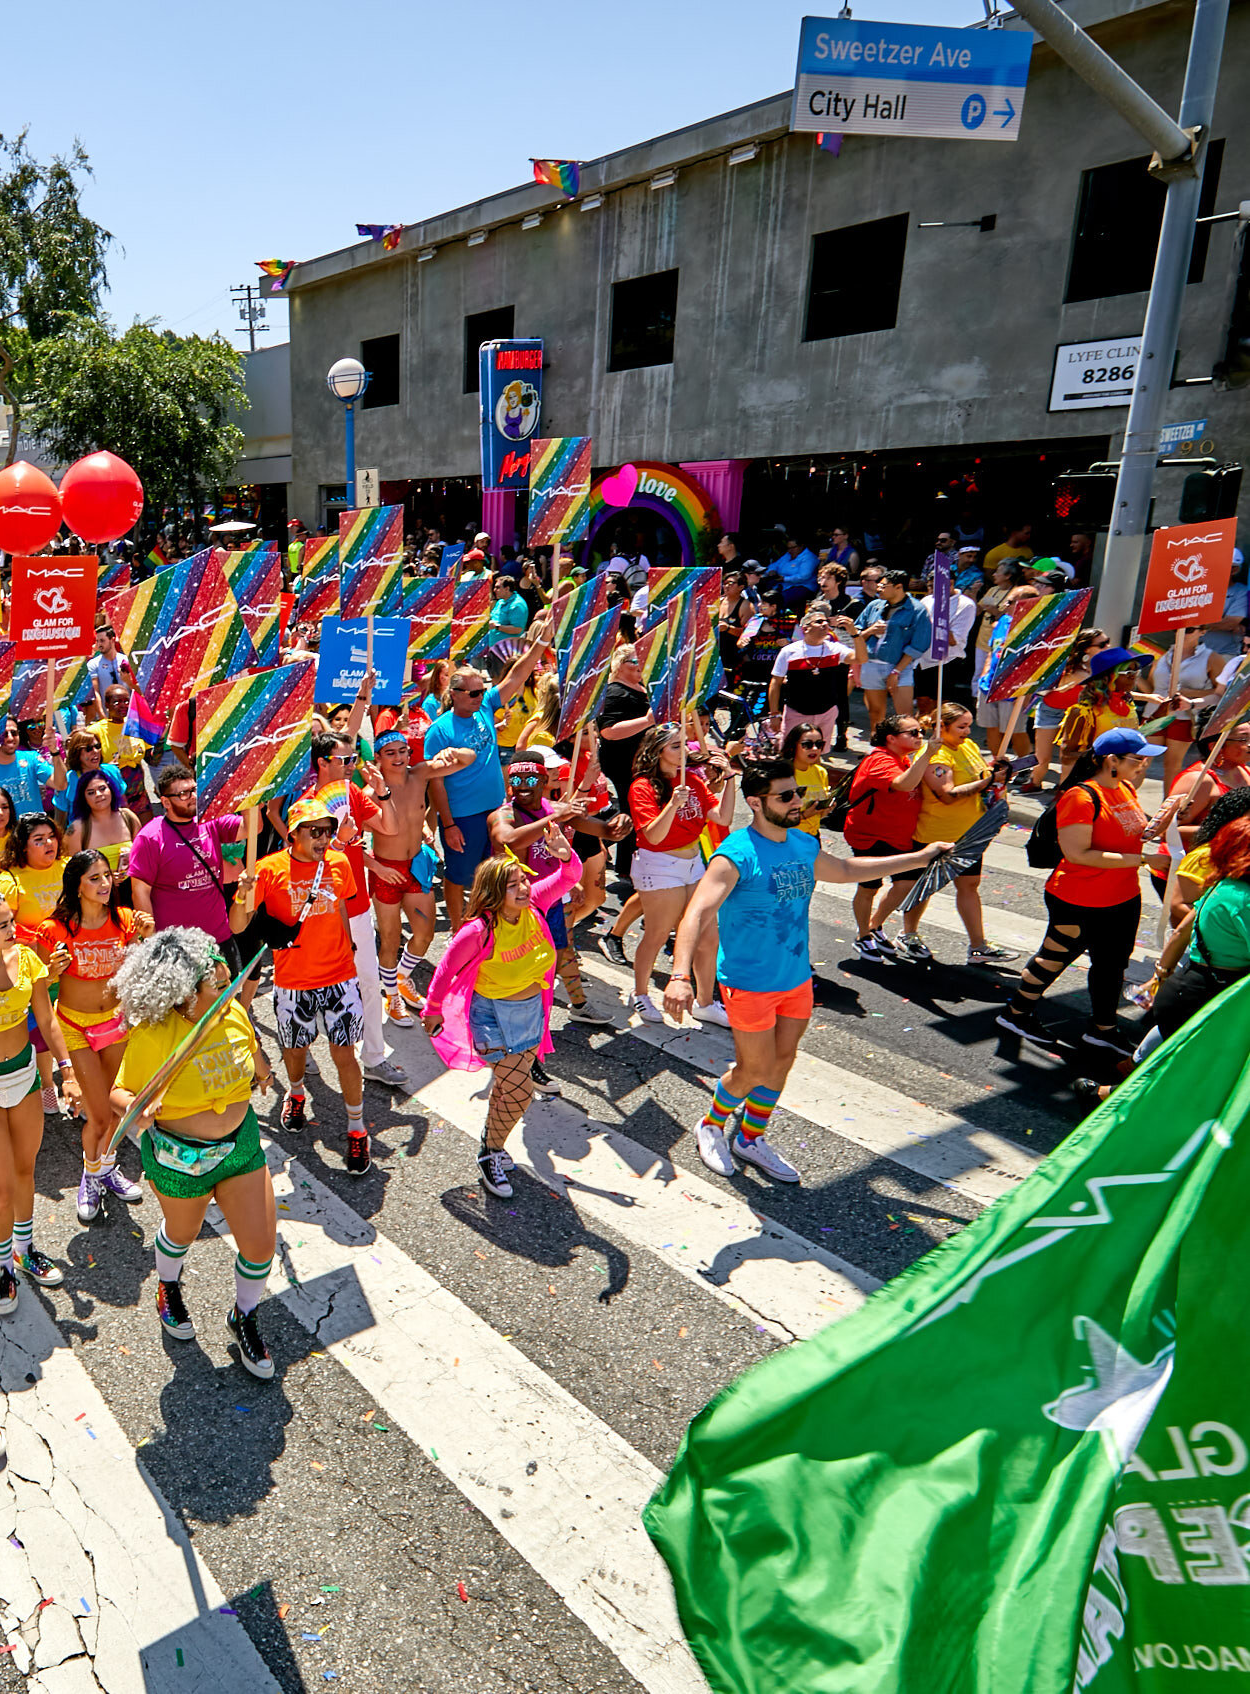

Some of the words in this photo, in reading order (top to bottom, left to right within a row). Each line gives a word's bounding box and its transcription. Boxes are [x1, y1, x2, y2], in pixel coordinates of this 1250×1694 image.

[814, 33, 923, 66] Sweetzer
[929, 42, 972, 69] Ave
[809, 91, 856, 122] City
[863, 94, 907, 120] Hall
[496, 349, 543, 371] HAMBURGER
[1068, 350, 1103, 363] LYFE
[1106, 345, 1142, 360] CLIN
[1082, 364, 1135, 384] 8286
[1159, 424, 1196, 444] SWEETZER
[638, 471, 678, 503] love
[1166, 586, 1191, 599] GLAM
[1192, 584, 1208, 596] FOR
[239, 603, 281, 617] AC
[1154, 591, 1214, 614] INCLUSION
[32, 618, 58, 628] GLAM
[58, 617, 74, 626] FOR
[21, 626, 82, 641] INCLUSION
